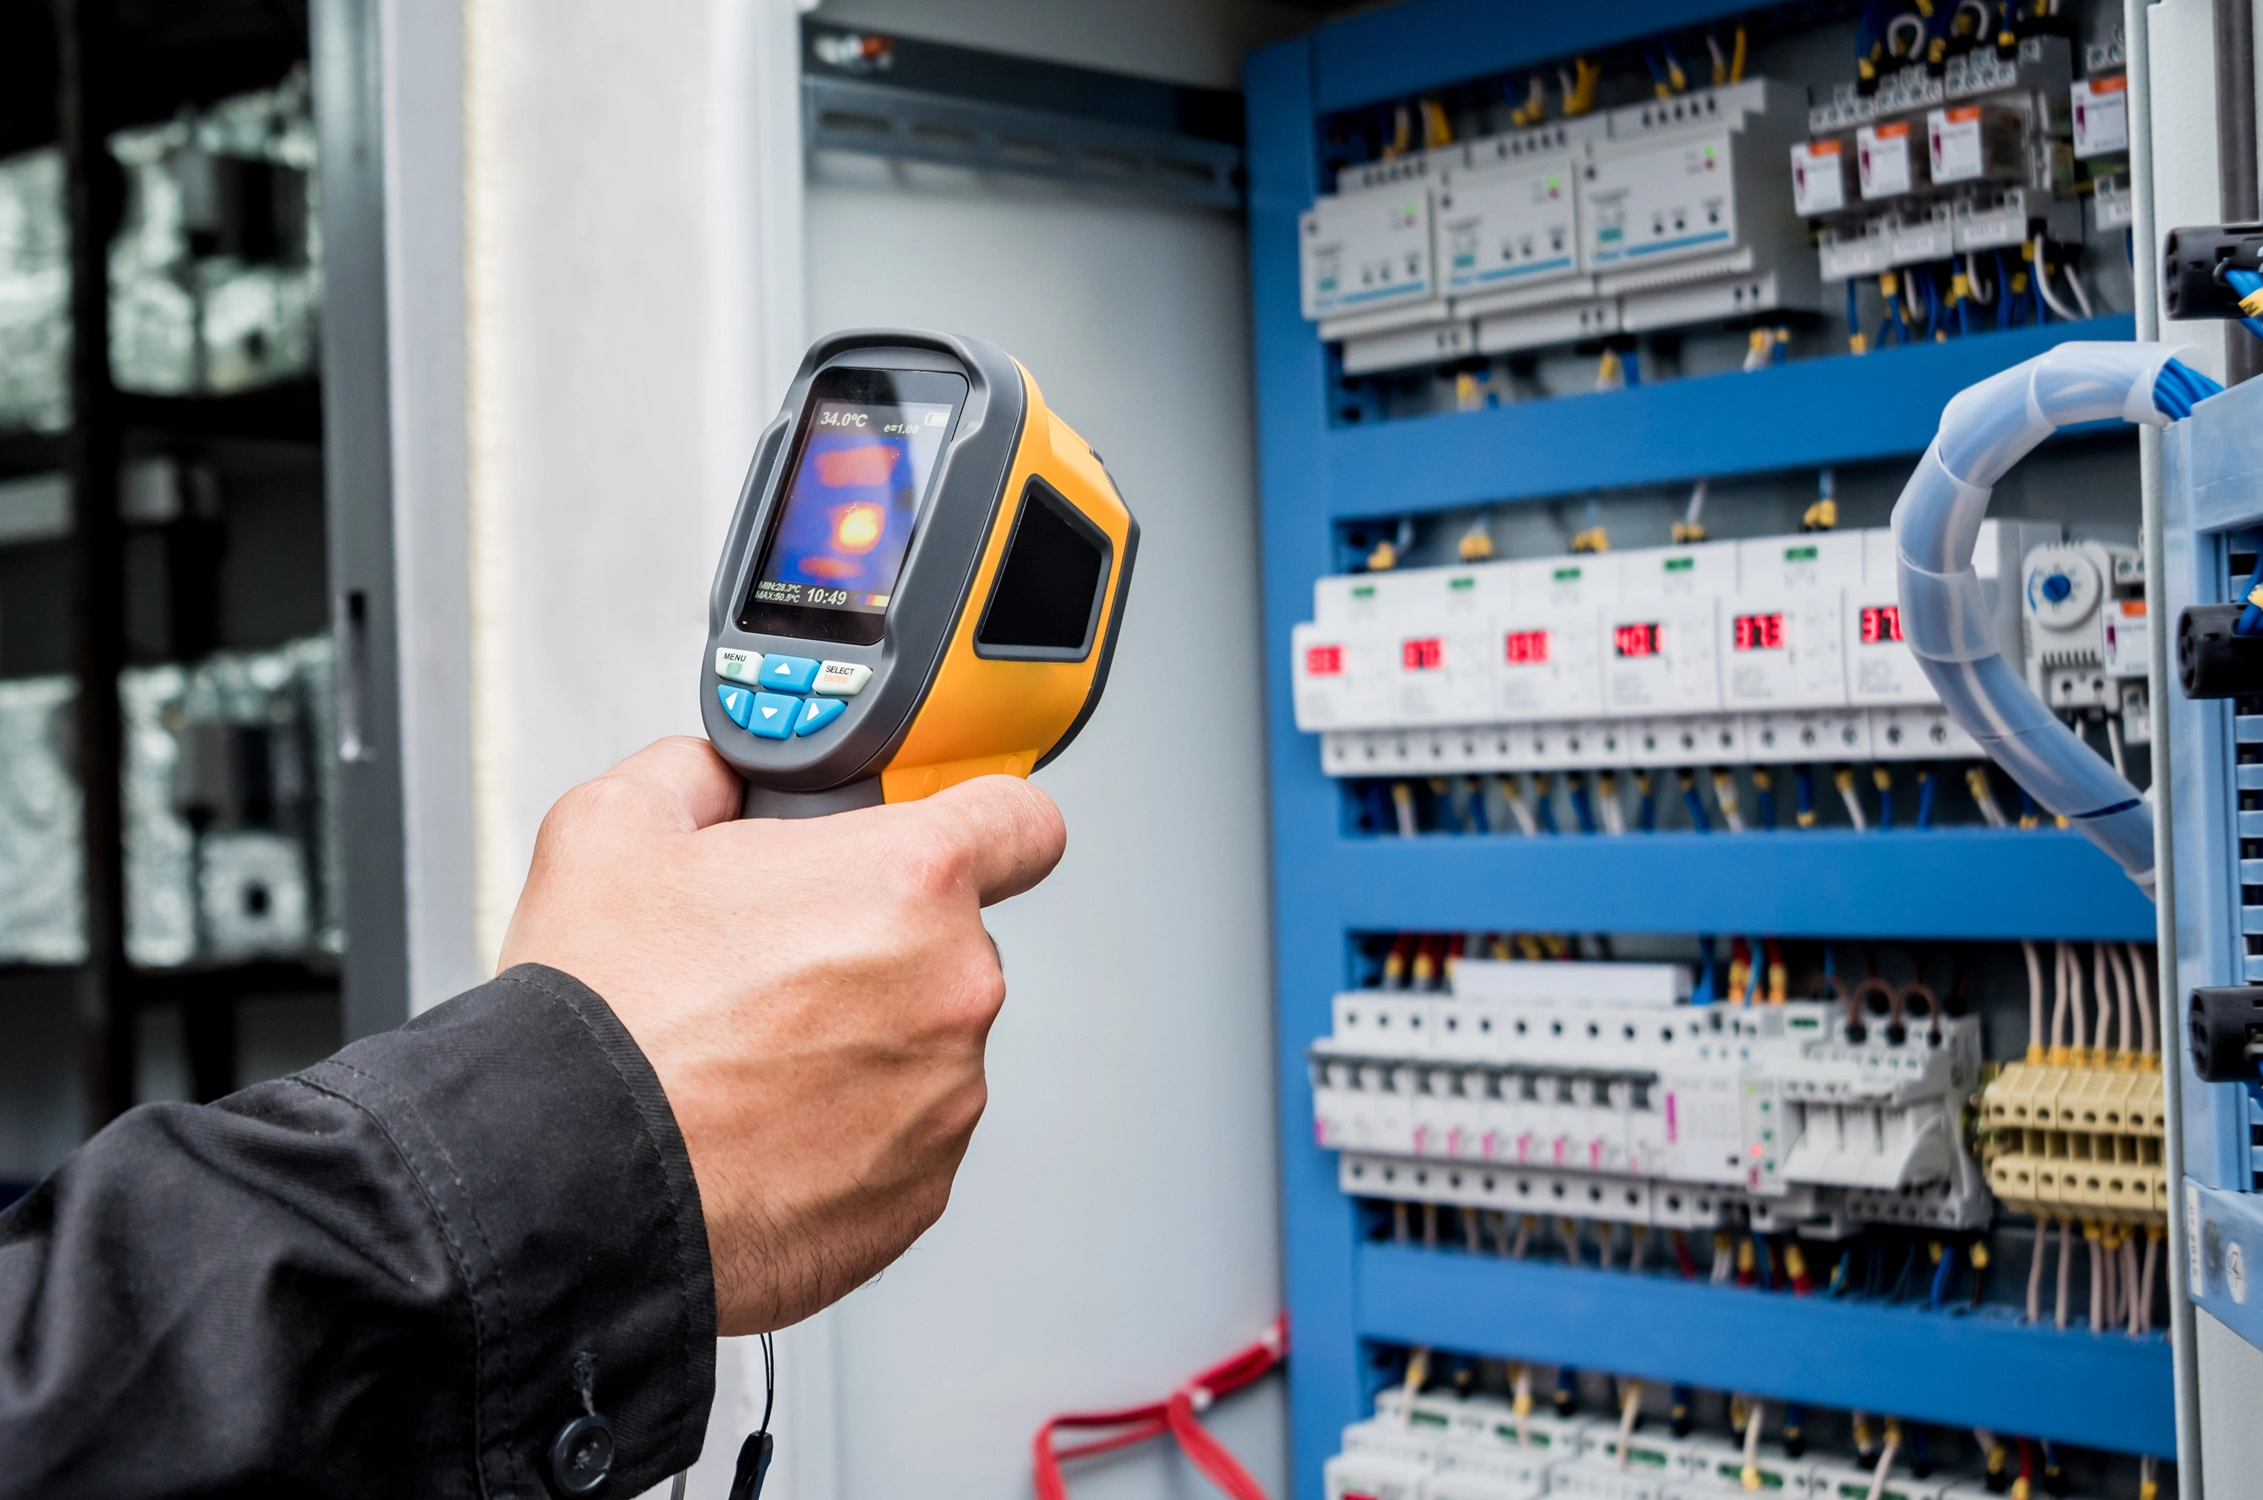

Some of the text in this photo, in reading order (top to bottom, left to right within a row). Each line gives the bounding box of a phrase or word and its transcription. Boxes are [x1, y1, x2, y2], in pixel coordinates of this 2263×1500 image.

[883, 423, 919, 435] e=1.00
[807, 587, 847, 606] 10:49
[1861, 606, 1905, 644] 37
[723, 652, 747, 662] MENU
[825, 665, 855, 676] SELECT
[823, 674, 849, 685] ENTER
